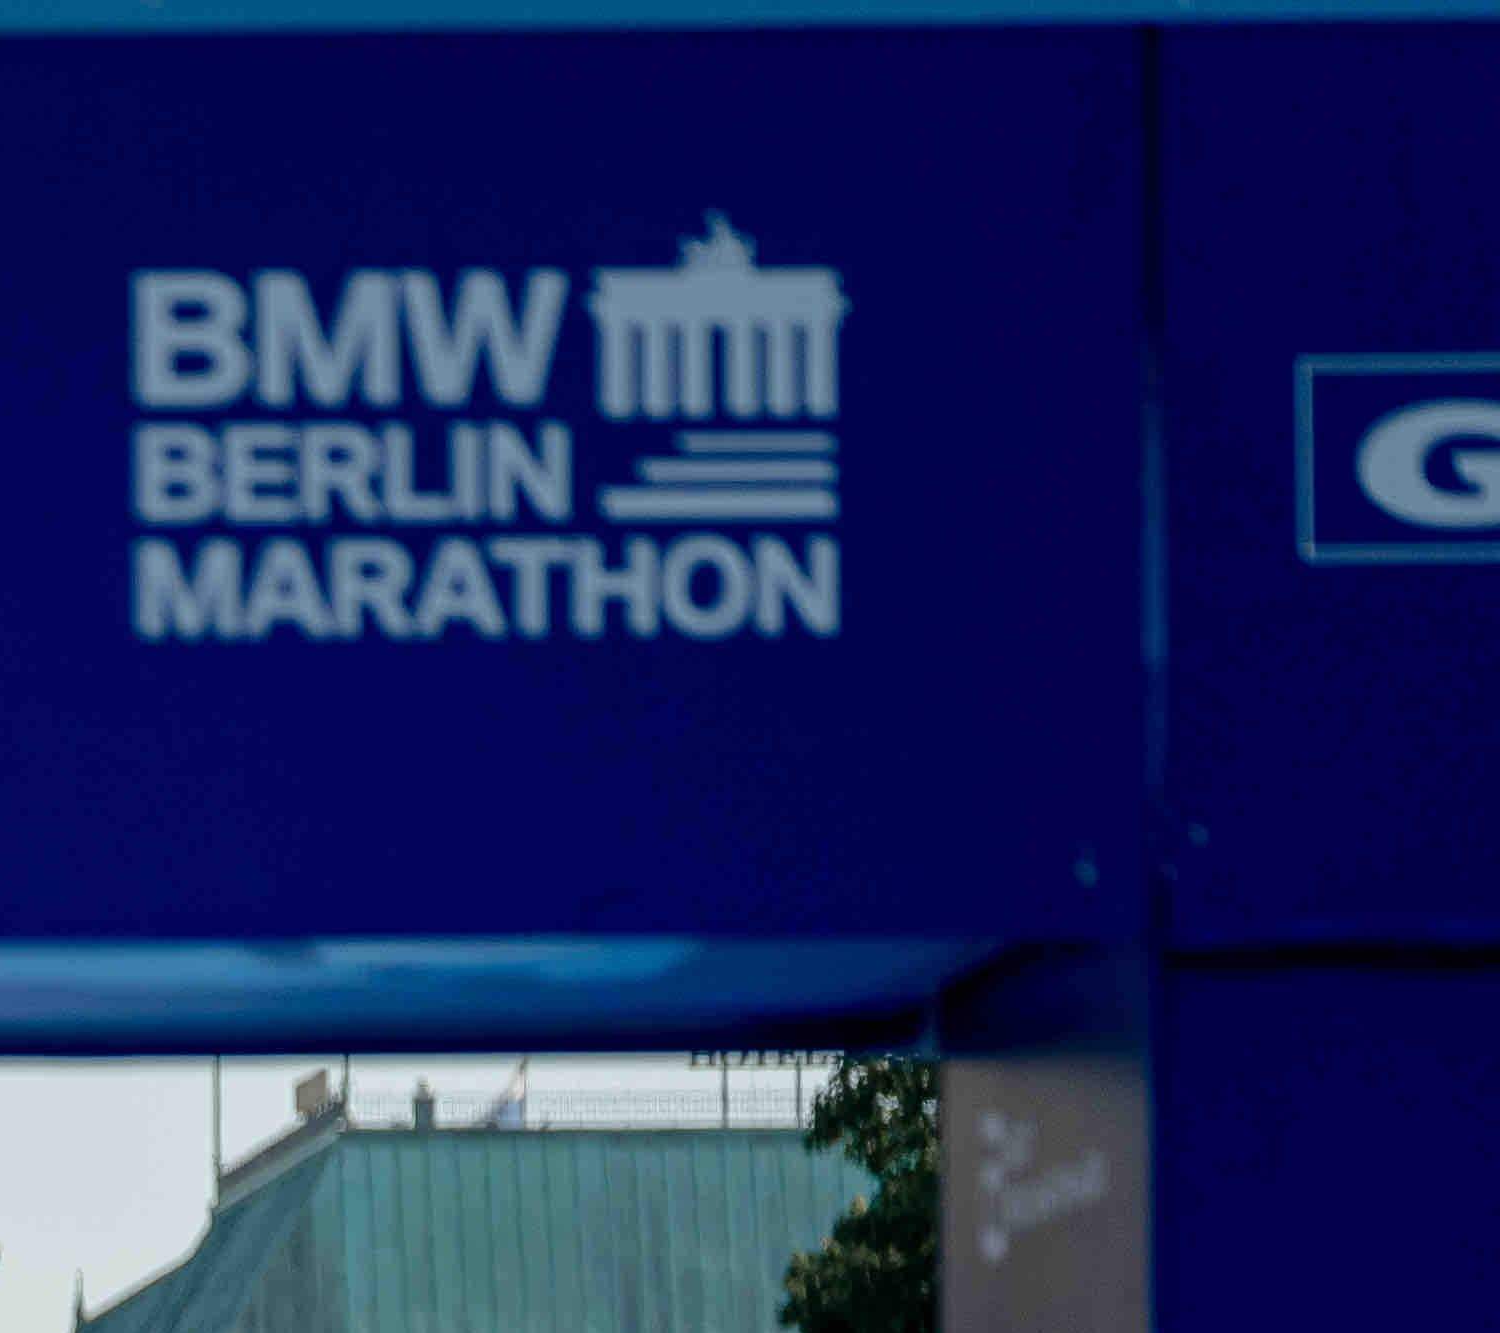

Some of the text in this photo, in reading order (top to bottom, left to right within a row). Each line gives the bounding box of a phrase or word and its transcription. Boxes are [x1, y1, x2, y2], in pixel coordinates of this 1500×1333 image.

[133, 269, 569, 407] BMW
[135, 422, 572, 523] BERLIN
[135, 536, 838, 638] MARATHON
